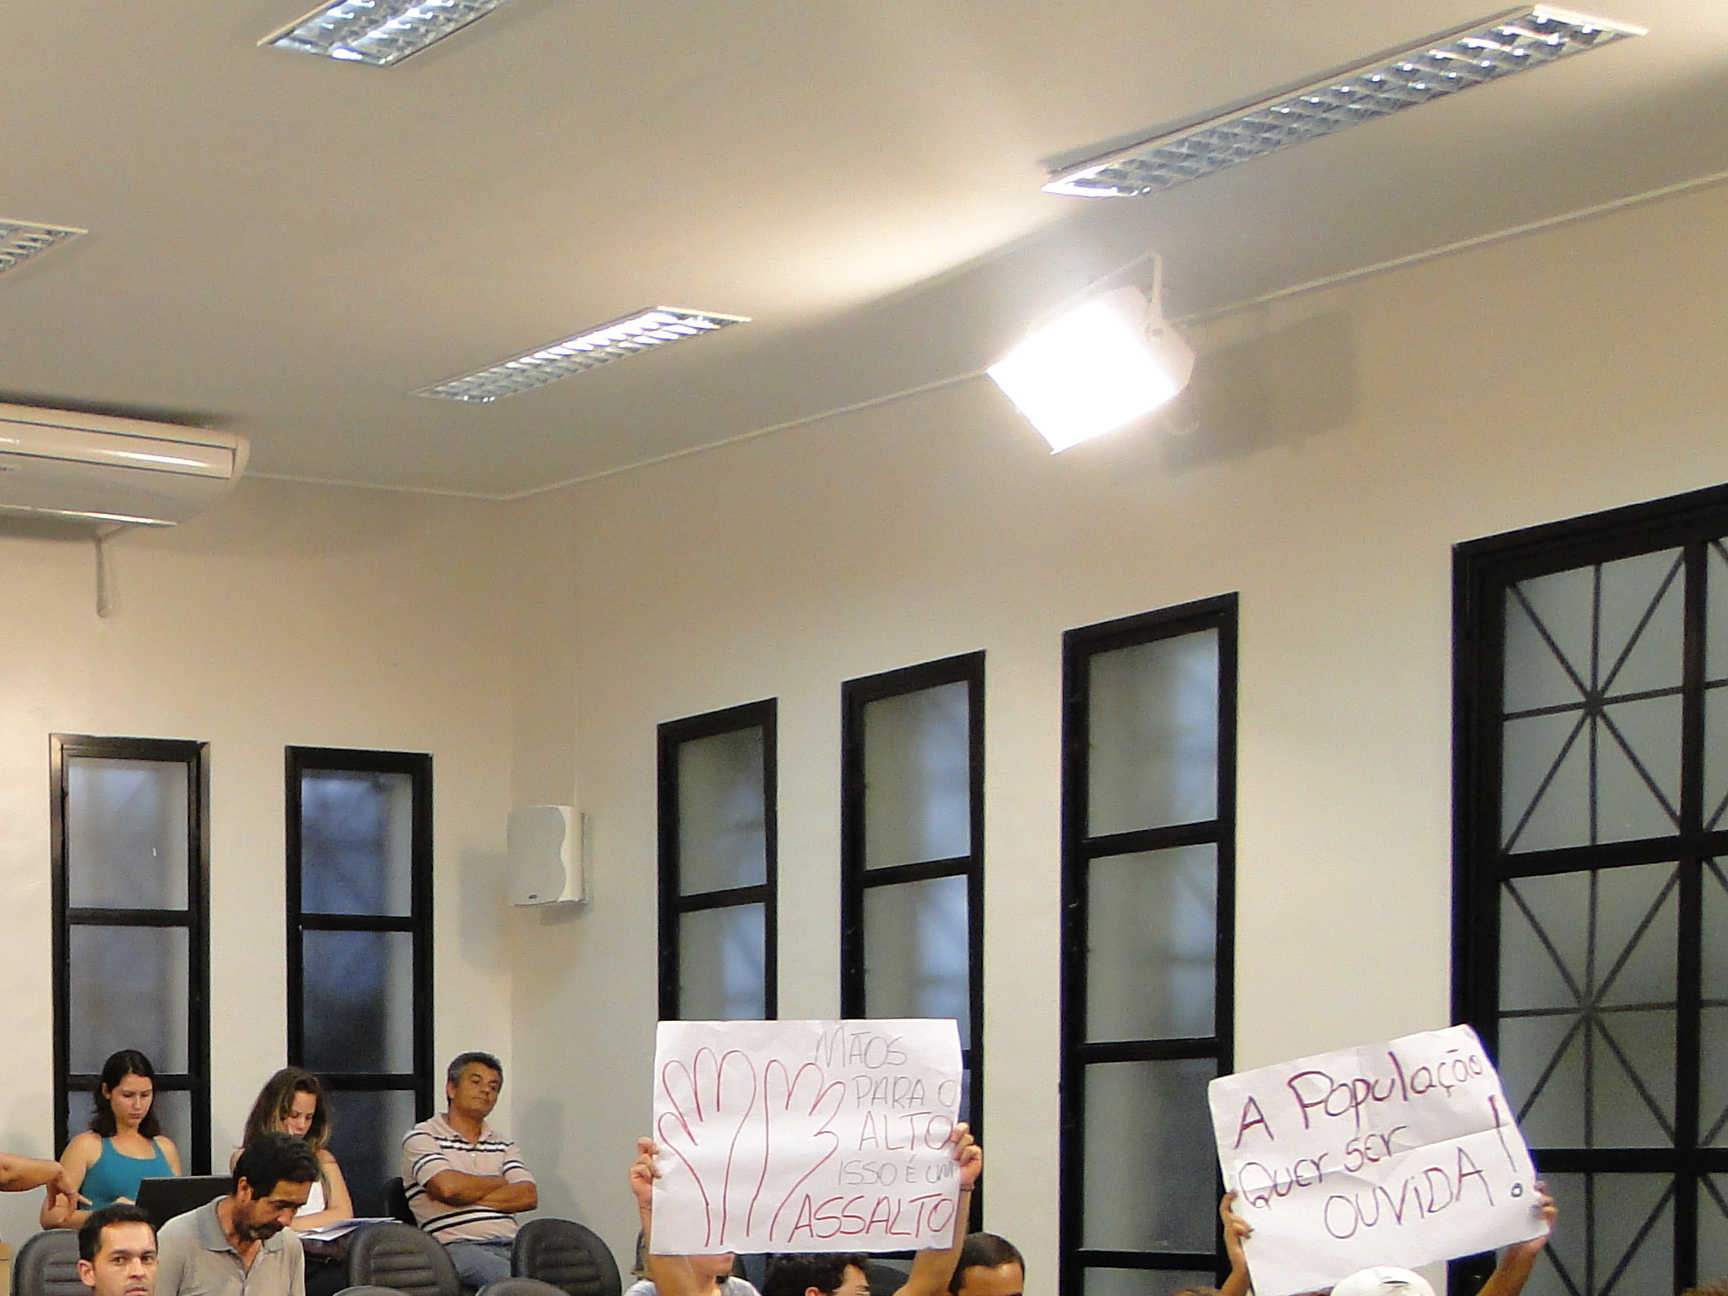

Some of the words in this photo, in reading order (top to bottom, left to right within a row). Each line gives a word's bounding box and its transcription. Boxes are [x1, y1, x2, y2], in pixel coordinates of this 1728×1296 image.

[813, 1025, 908, 1069] MÃOS
[852, 1074, 926, 1110] PARA
[937, 1078, 958, 1109] O
[858, 1110, 955, 1152] ALTO
[1233, 1095, 1275, 1151] A
[837, 1159, 898, 1187] ISSO
[905, 1155, 918, 1185] É
[925, 1160, 955, 1183] UM
[787, 1192, 955, 1244] ASSALTO
